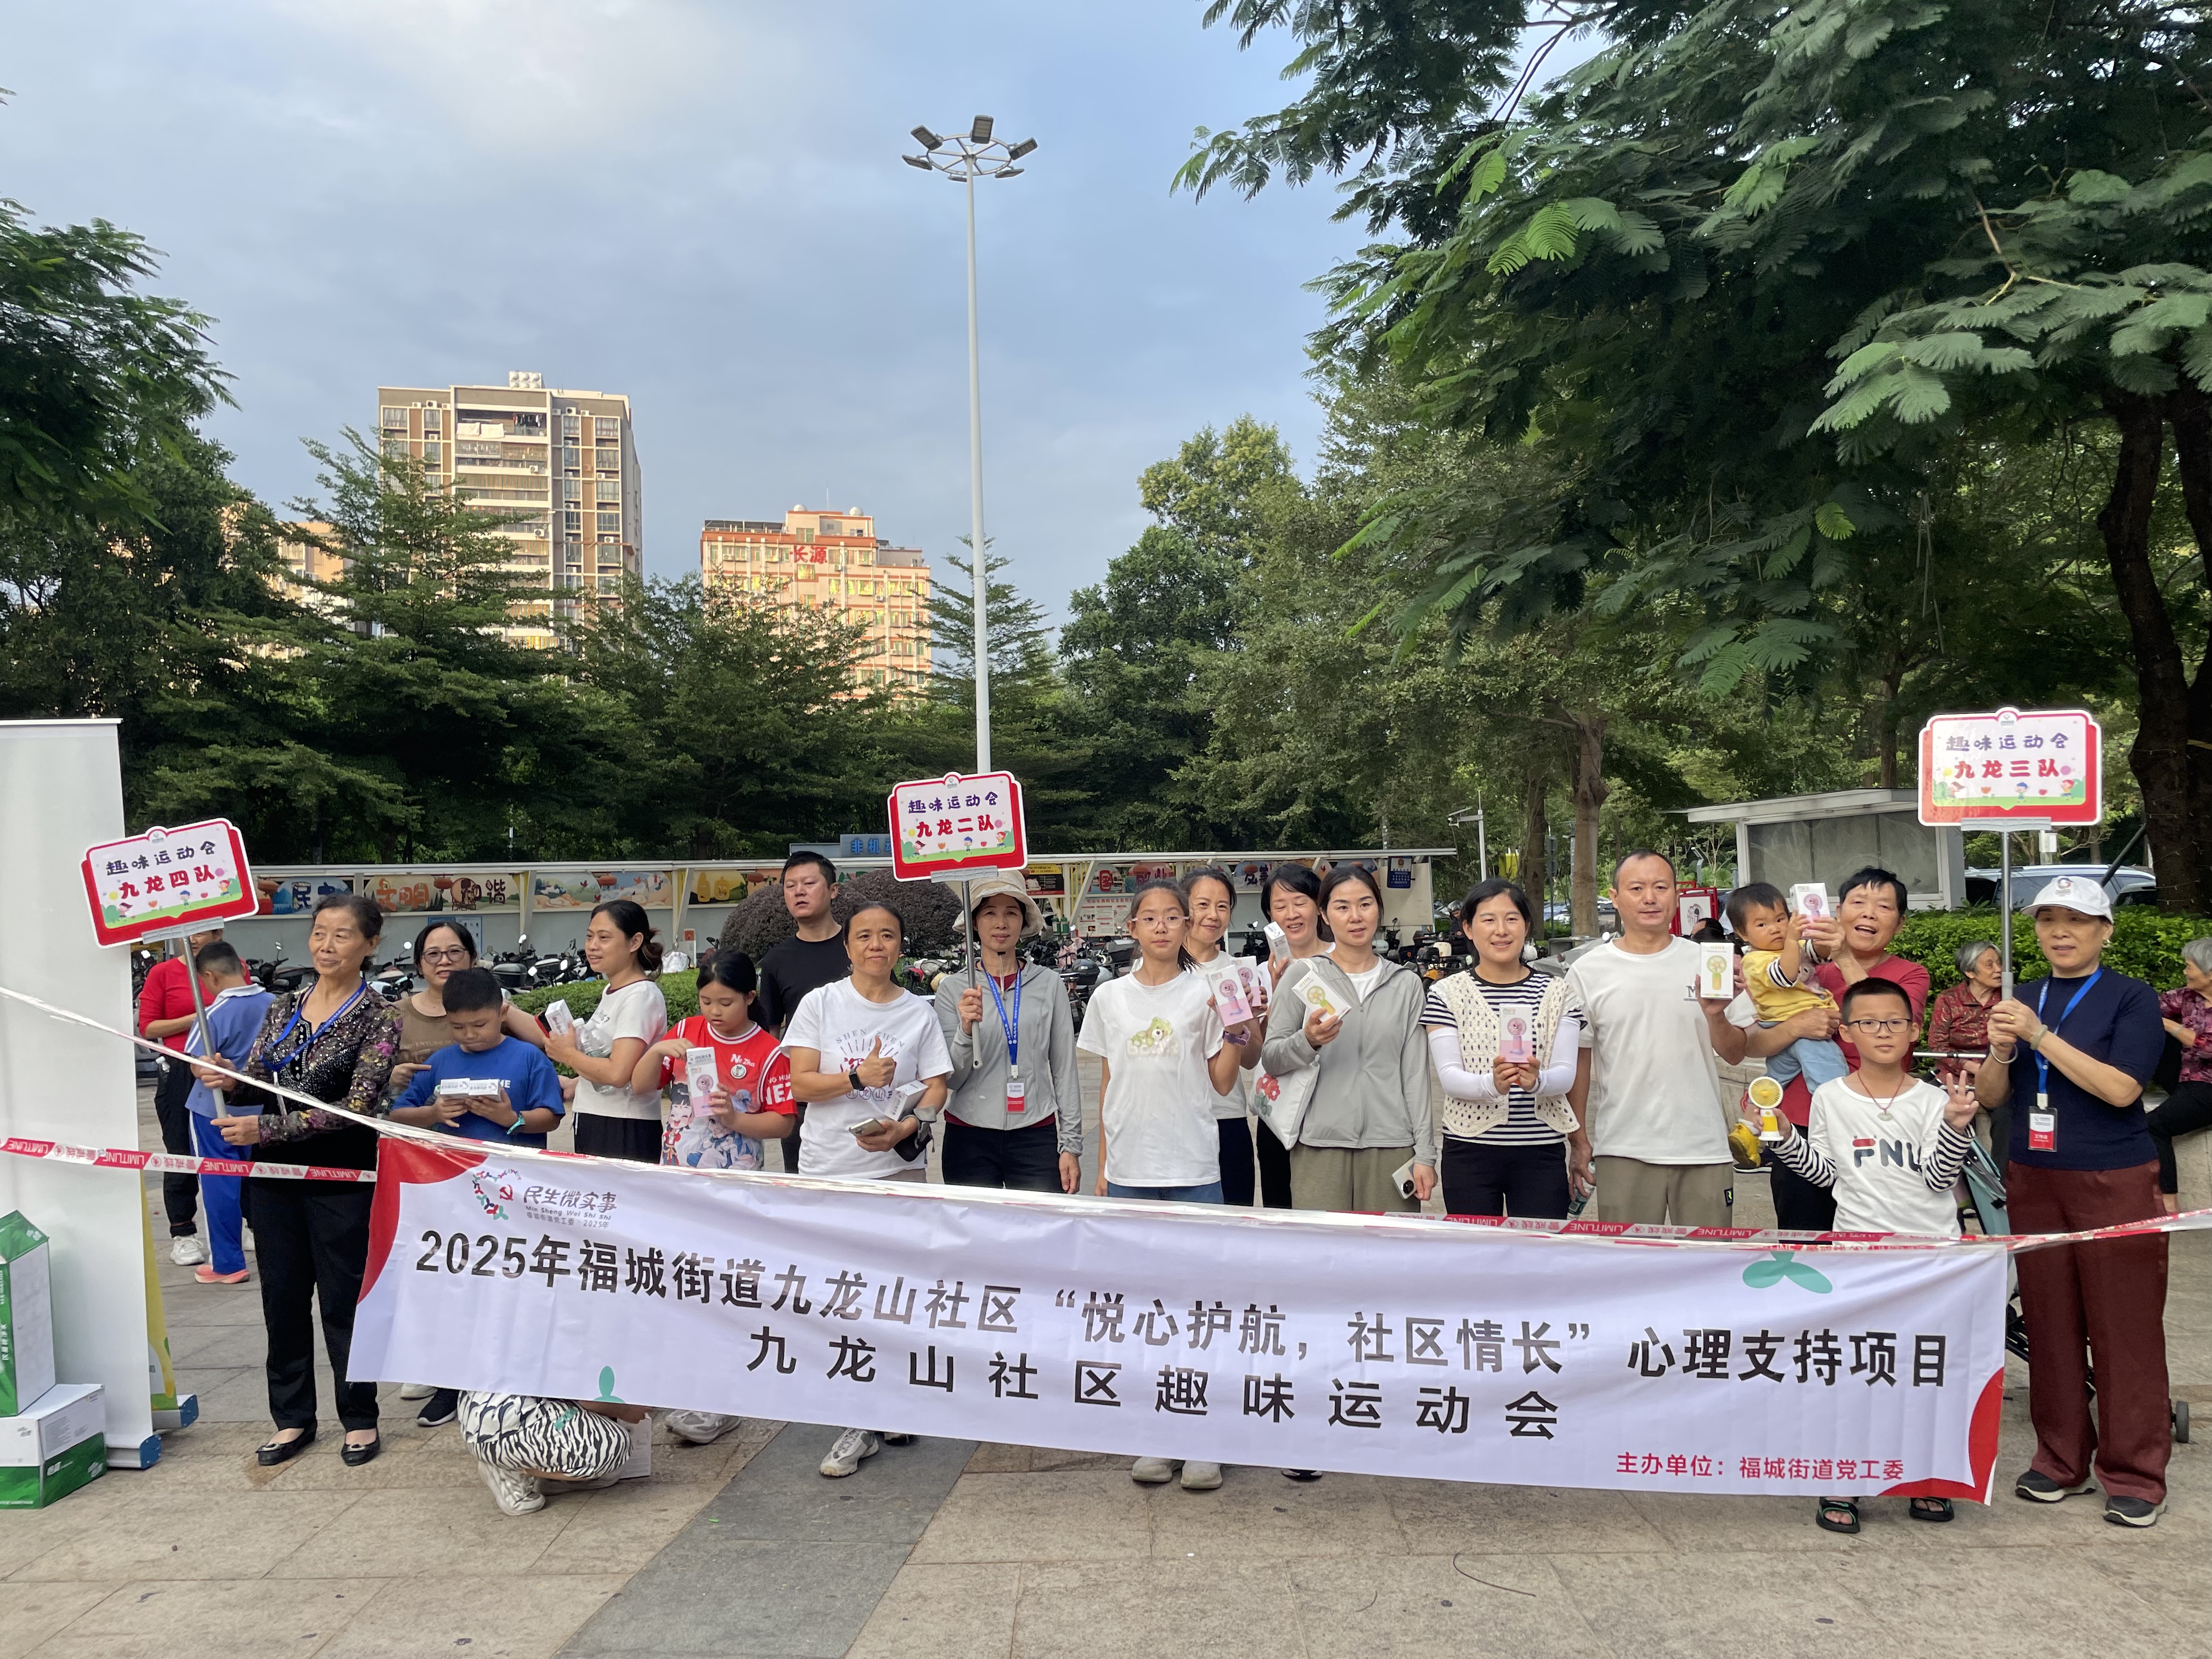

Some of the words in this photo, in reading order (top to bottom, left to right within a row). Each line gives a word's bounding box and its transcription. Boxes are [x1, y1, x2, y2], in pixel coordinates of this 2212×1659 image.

[789, 545, 828, 564] 长源
[1946, 732, 2068, 752] 趣味运动会
[1954, 758, 2059, 778] 九龙三队
[908, 791, 998, 814] 趣味运动会
[916, 814, 995, 838] 九龙二队
[106, 840, 215, 876] 趣味运动会
[119, 865, 215, 899] 九龙四队
[376, 878, 429, 911] 文明
[836, 1029, 866, 1044] SHEN
[876, 1030, 905, 1047] ZHEN
[731, 1053, 742, 1064] Ne
[743, 1058, 755, 1068] Zha
[8, 1140, 48, 1154] LIMITLINE
[103, 1153, 145, 1165] LIMITLINE
[204, 1161, 249, 1173] LIMITLINE
[309, 1169, 357, 1179] LIMITLINE
[524, 1186, 617, 1213] 民生微实事
[541, 1207, 562, 1217] Sheng
[1570, 1223, 1623, 1232] LIMITLINE
[1698, 1228, 1752, 1237] LIMITLINE
[747, 1325, 1559, 1440] 九龙山社区趣味运动会
